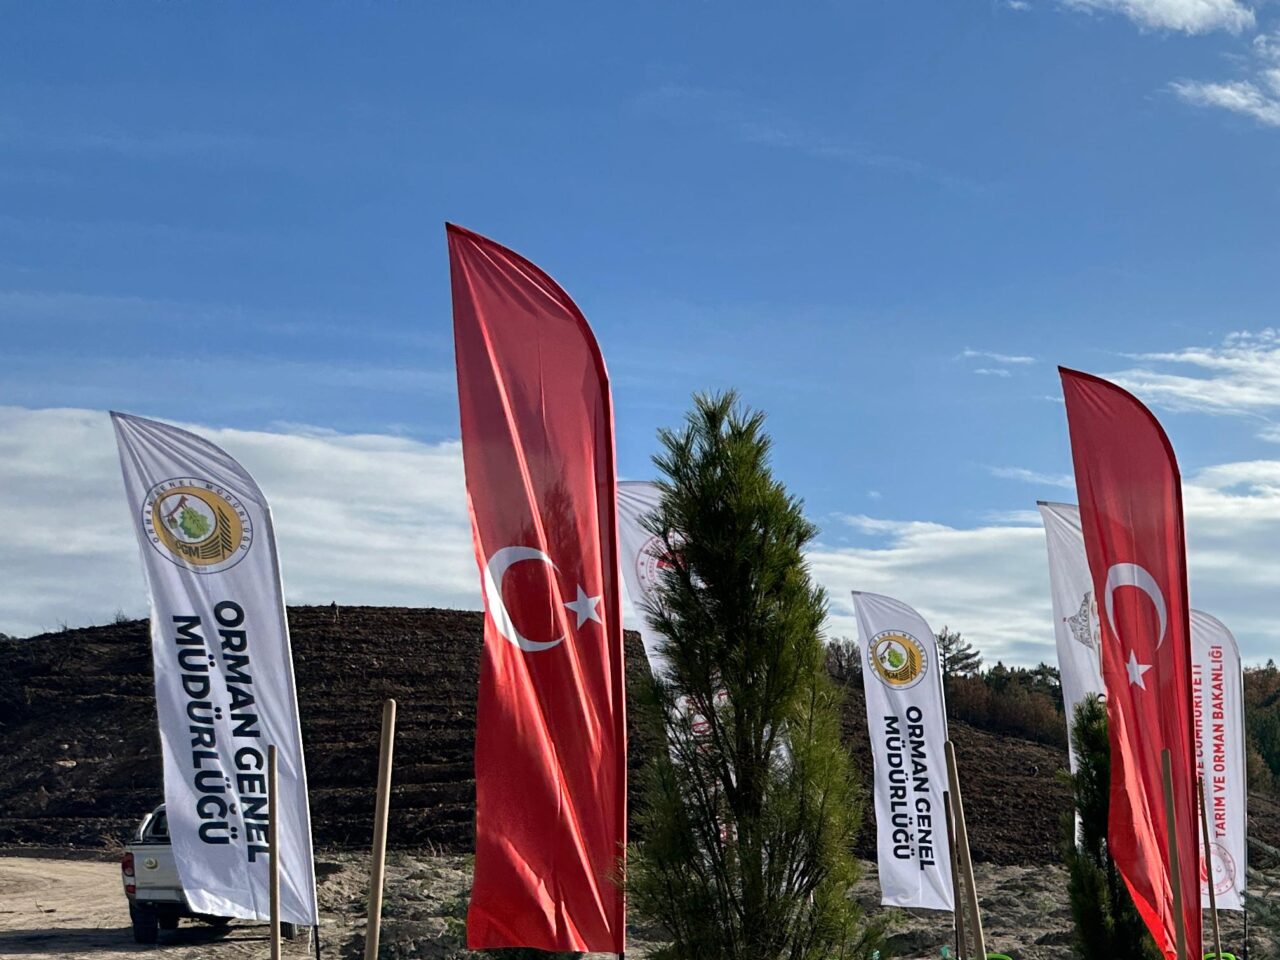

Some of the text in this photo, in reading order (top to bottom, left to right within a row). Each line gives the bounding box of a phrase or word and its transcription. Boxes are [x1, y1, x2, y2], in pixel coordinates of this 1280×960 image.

[172, 615, 239, 845] MÜDÜRLÜĞÜ
[213, 600, 271, 863] ORMAN GENEL
[883, 715, 916, 860] MÜDÜRLÜĞÜ
[905, 706, 936, 871] ORMAN GENEL
[1208, 645, 1226, 838] TARIM VE ORMAN BAKANLIĞI
